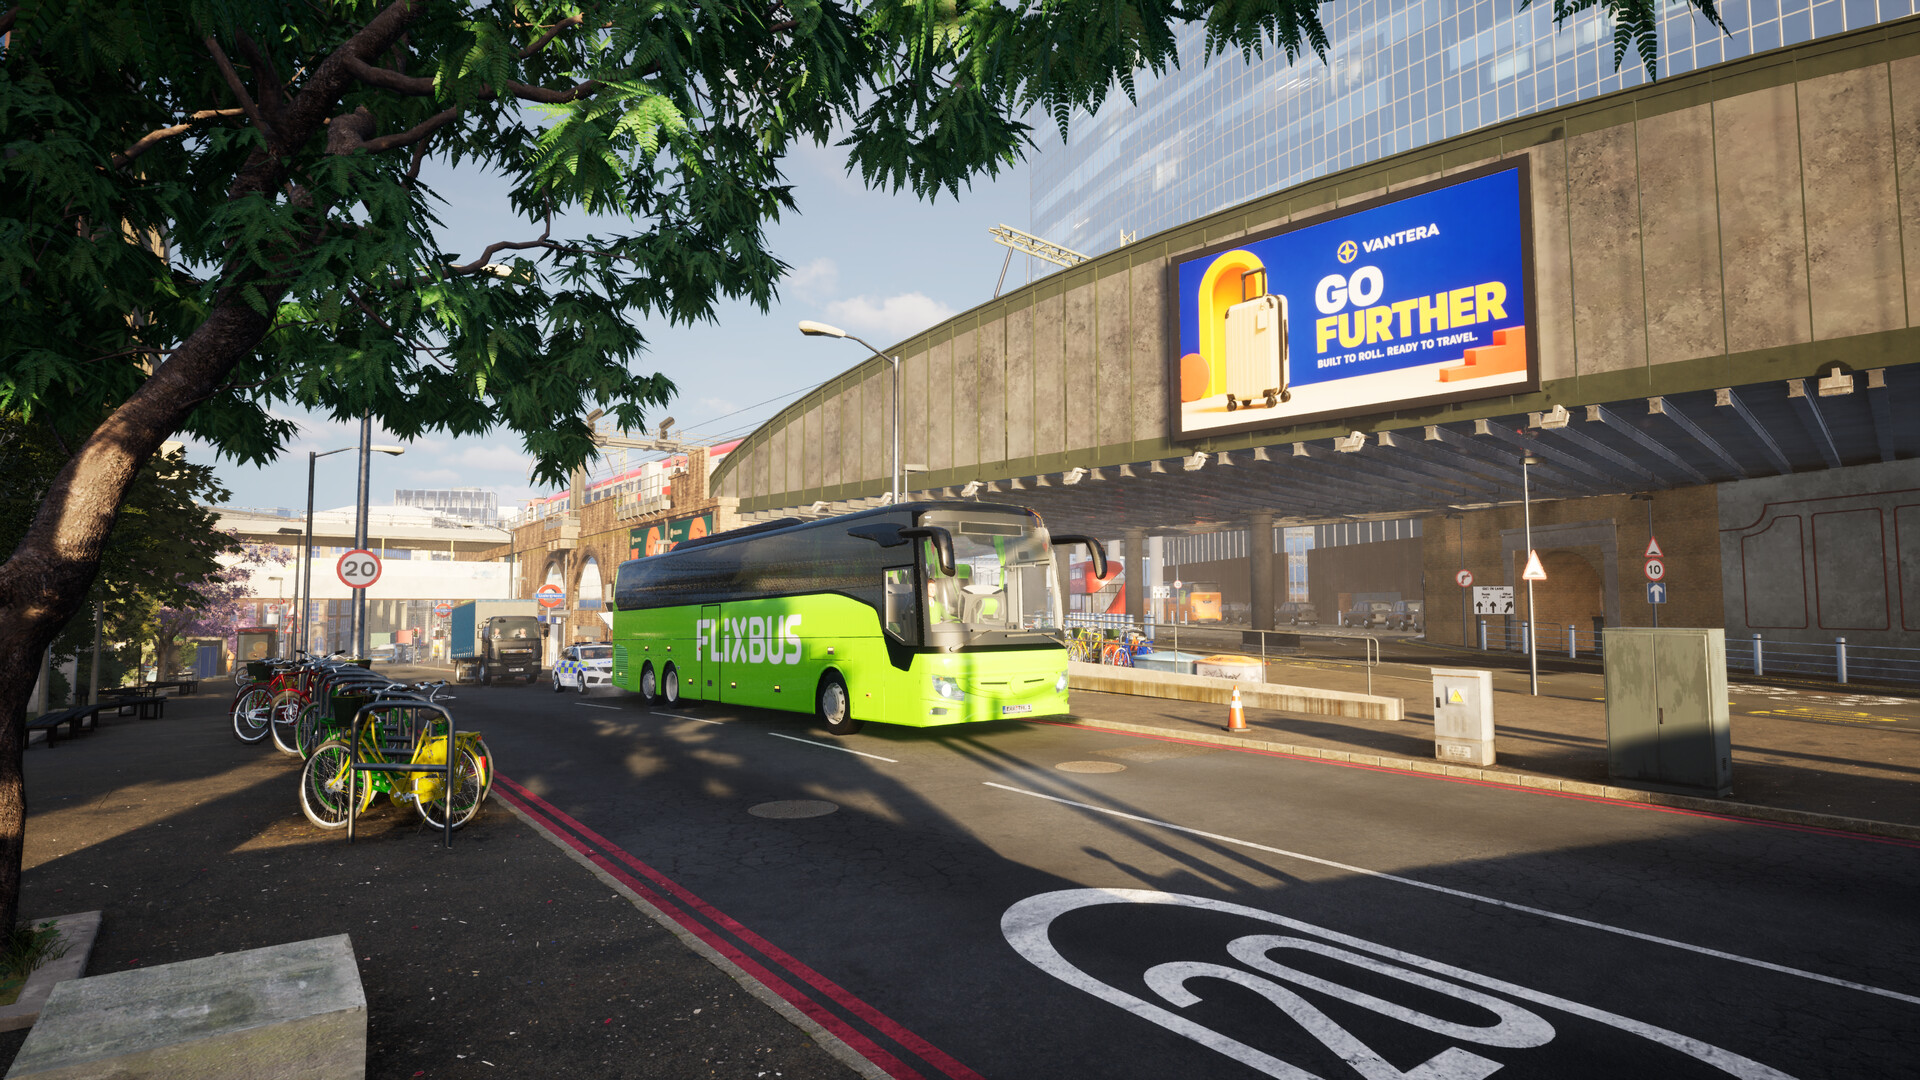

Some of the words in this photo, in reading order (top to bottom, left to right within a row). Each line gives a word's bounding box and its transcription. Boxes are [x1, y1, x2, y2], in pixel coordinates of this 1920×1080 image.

[1362, 222, 1440, 253] VANTERA
[1315, 265, 1384, 314] GO
[1316, 281, 1508, 354] FURTHER
[1317, 356, 1342, 369] BUILT
[1344, 353, 1357, 364] TO
[1358, 348, 1385, 361] ROLL.
[1387, 342, 1419, 356] READY
[1420, 339, 1435, 350] TO
[1436, 331, 1479, 347] TRAVEL.
[344, 560, 376, 577] 20
[1648, 564, 1661, 575] 10
[1143, 934, 1556, 1080] 20
